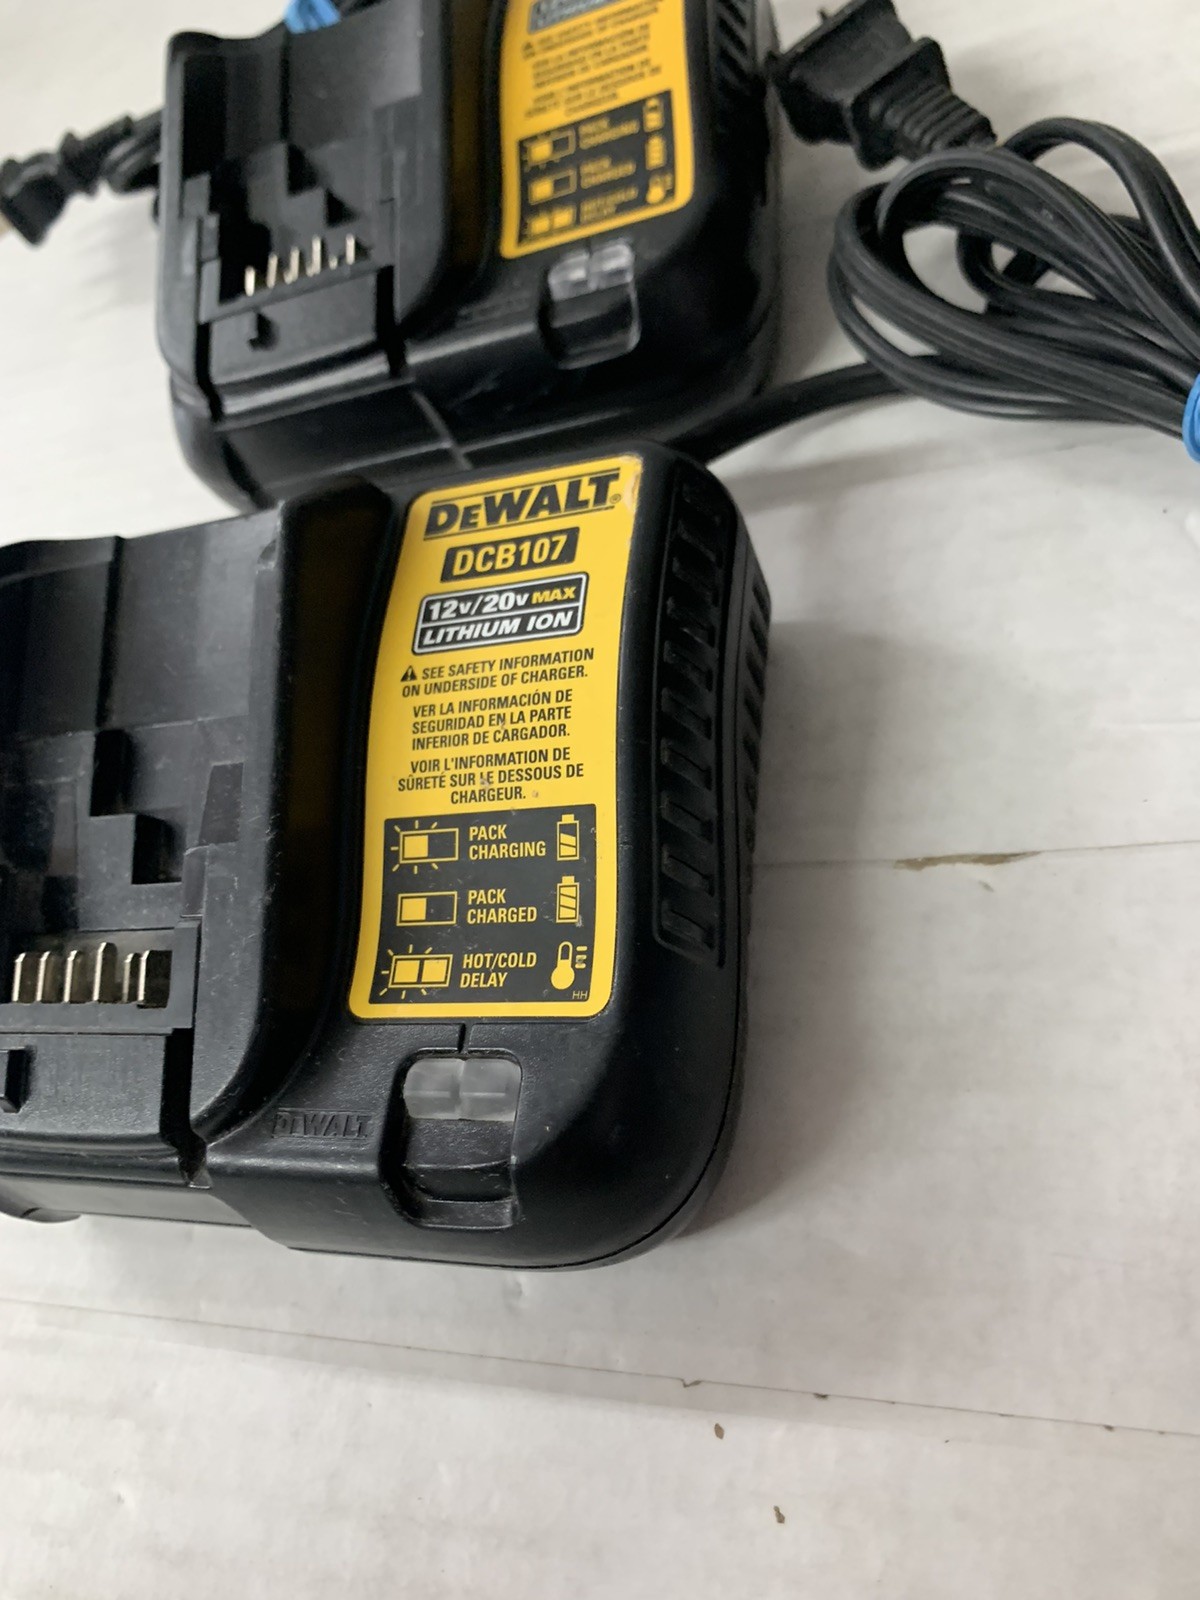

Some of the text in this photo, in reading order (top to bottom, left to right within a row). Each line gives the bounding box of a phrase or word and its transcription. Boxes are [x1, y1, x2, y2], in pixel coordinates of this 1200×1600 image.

[453, 535, 568, 576] DCB107
[531, 586, 576, 604] MAX
[423, 611, 573, 645] LITHIUM ION
[422, 648, 594, 680] SEE SAFETY INFORMATION
[402, 666, 588, 697] ON UNDERSIDE OF CHARGER.
[413, 689, 573, 718] VER LA INFORMACIÓN DE
[412, 706, 571, 734] SEGURIDAD EN LA PARTE
[412, 724, 570, 750] INFERIOR DE CARGADOR.
[411, 747, 571, 773] VOIR L'INFORMATION DE
[398, 773, 446, 791] SÛRETÉ
[450, 774, 475, 787] SUR
[498, 765, 562, 783] DESSOUS
[566, 764, 584, 777] DE
[451, 786, 526, 804] CHARGEUR.
[469, 824, 507, 841] PACK
[469, 841, 546, 861] CHARGING
[468, 889, 506, 905] PACK
[467, 907, 537, 924] CHARGED
[463, 953, 537, 970] HOT/COLD
[460, 972, 507, 988] DELAY
